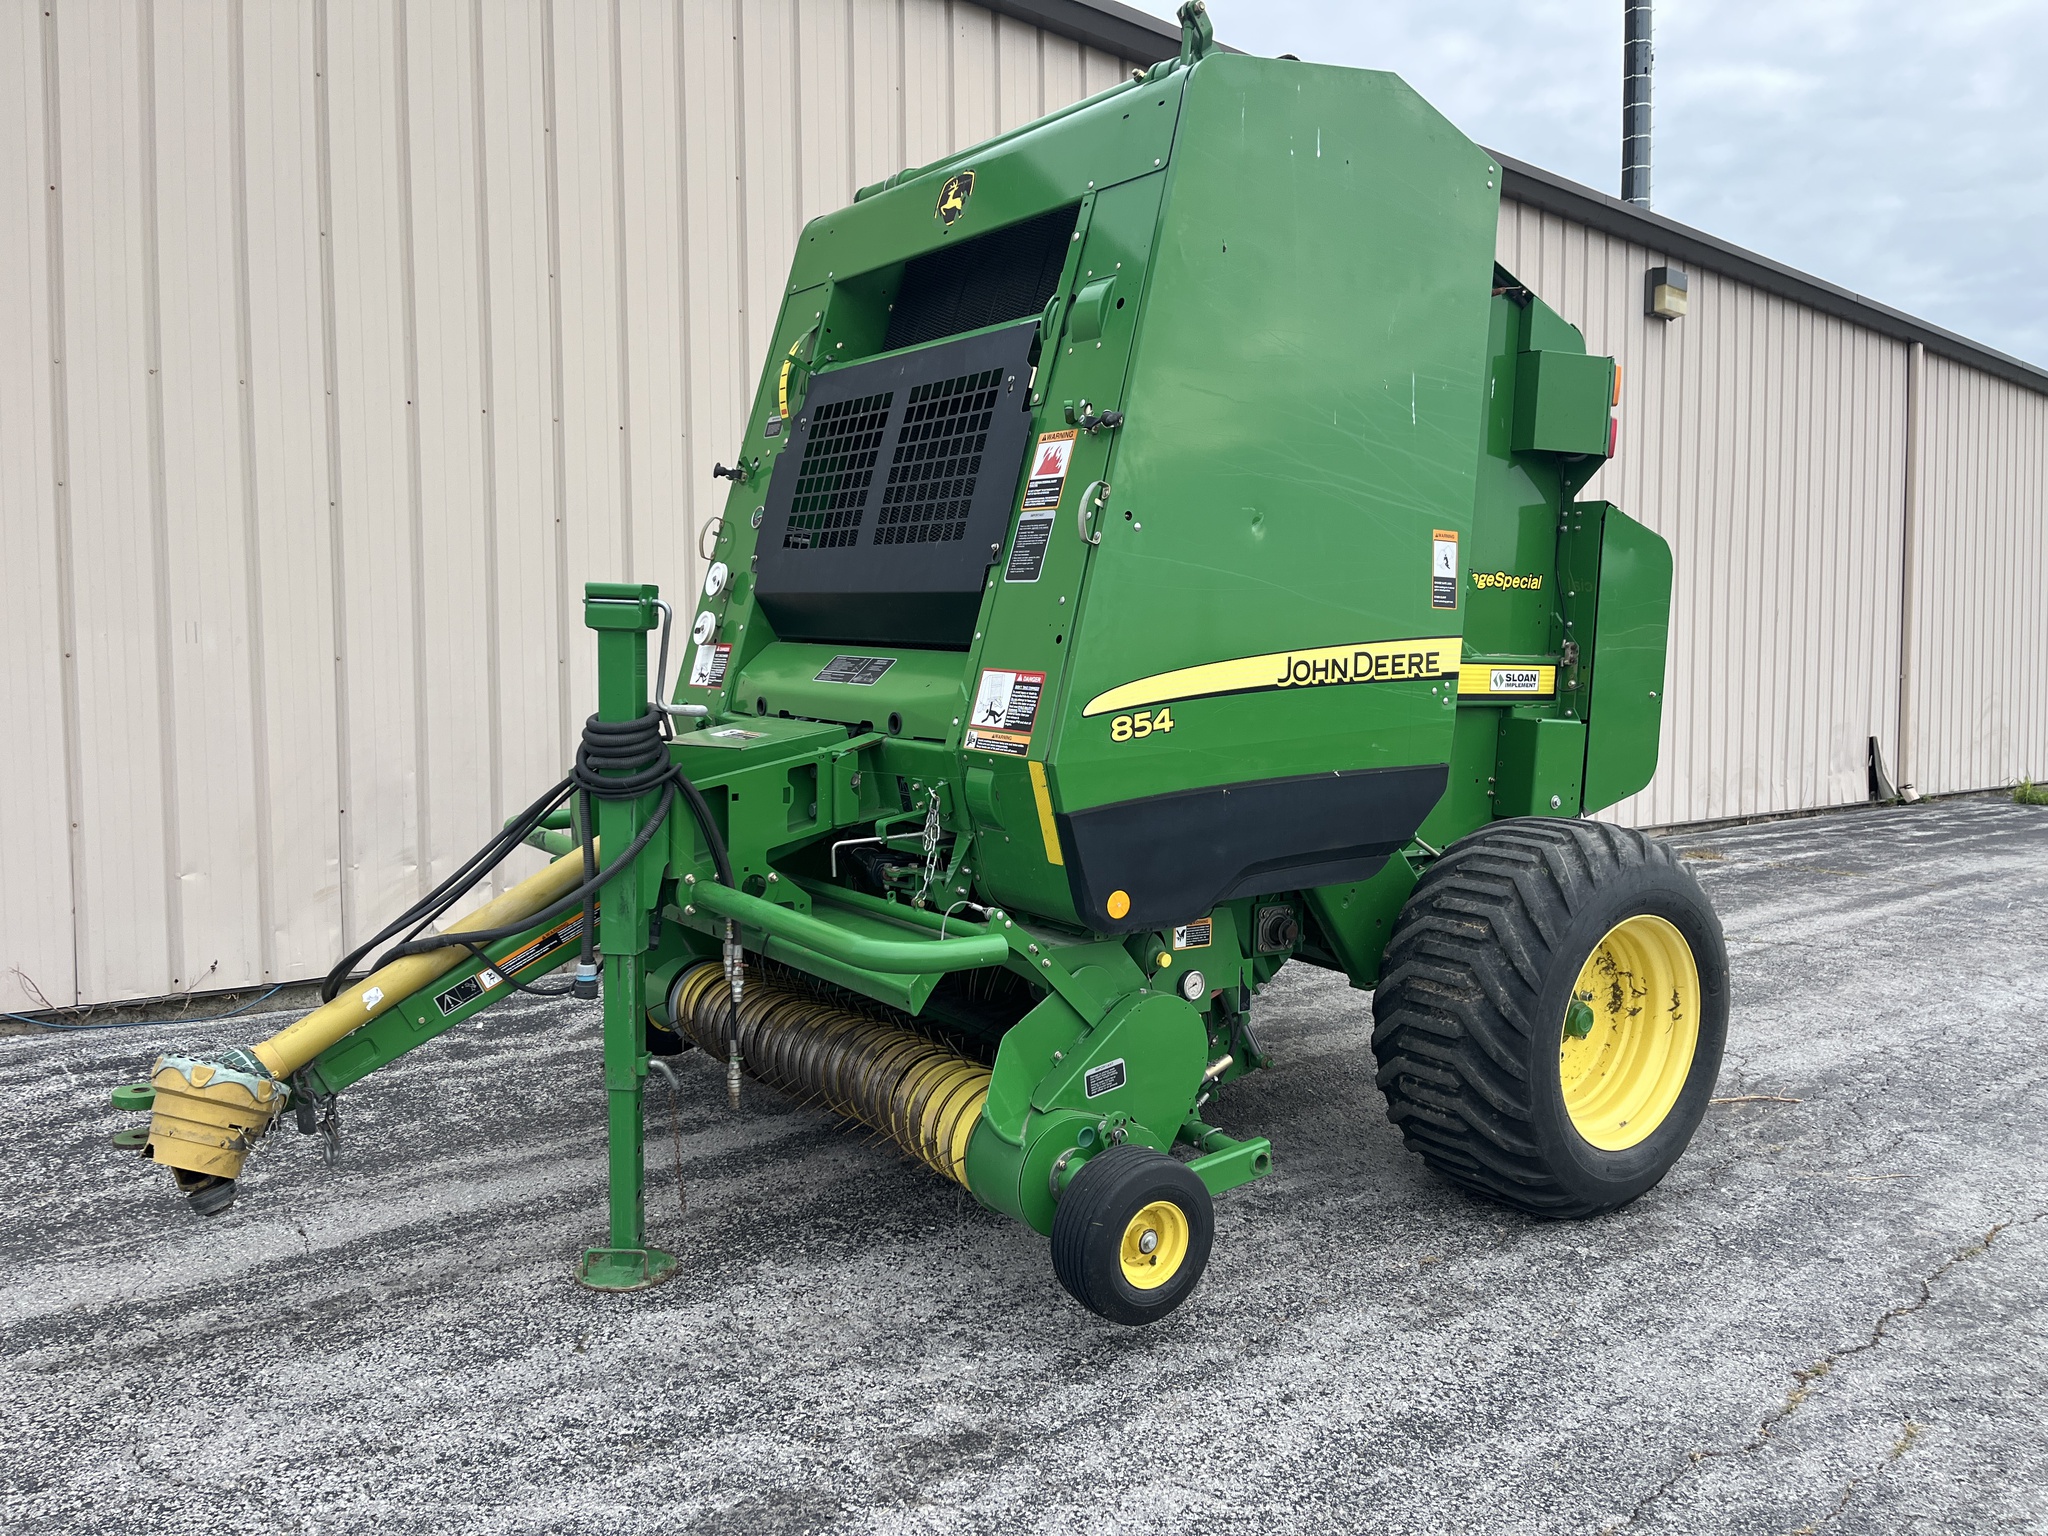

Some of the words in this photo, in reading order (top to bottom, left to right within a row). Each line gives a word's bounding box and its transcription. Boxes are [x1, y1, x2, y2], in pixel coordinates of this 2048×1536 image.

[1046, 430, 1074, 440] WARNING
[1277, 655, 1348, 685] JOHN
[1353, 651, 1441, 679] DEERE
[1505, 673, 1537, 682] SLOAN
[1110, 706, 1175, 743] 854
